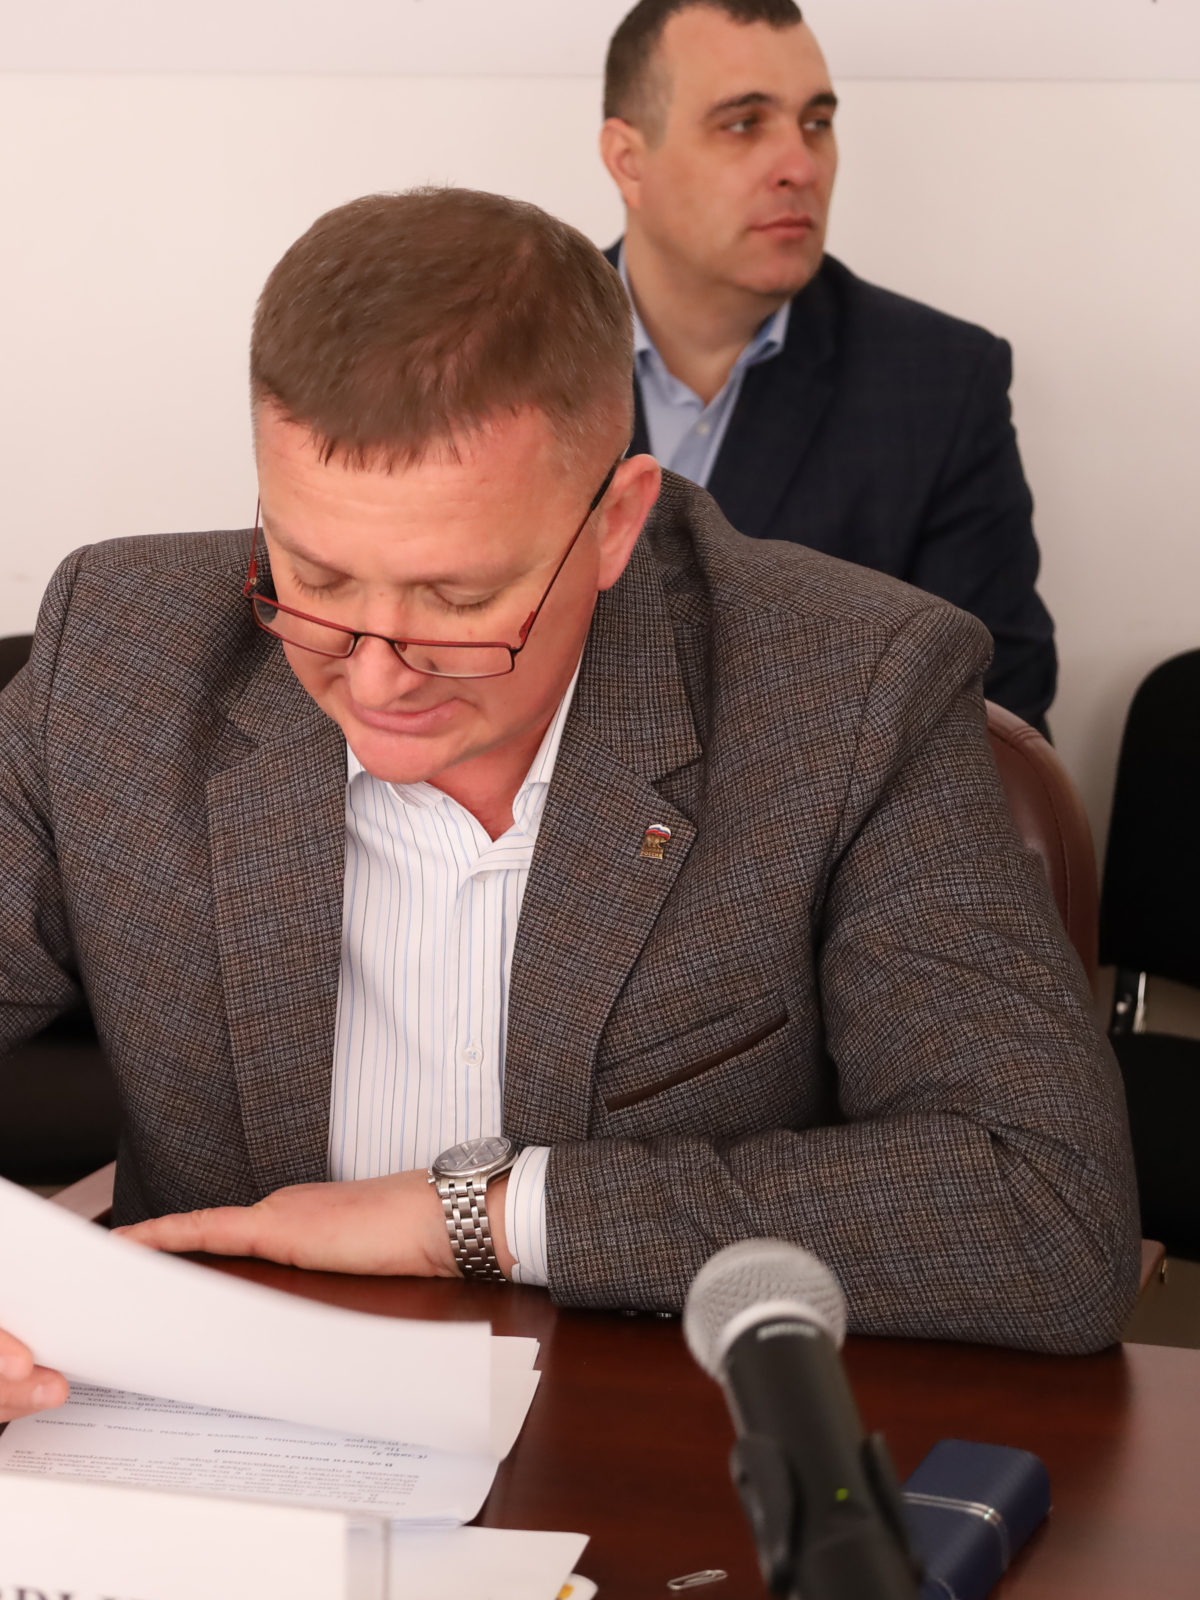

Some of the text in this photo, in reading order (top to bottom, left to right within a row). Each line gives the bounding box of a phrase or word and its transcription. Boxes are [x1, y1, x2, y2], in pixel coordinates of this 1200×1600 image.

[35, 1419, 98, 1428] дренажных
[207, 1433, 258, 1441] остаются
[265, 1437, 337, 1447] проблемным
[214, 1449, 281, 1458] отношений
